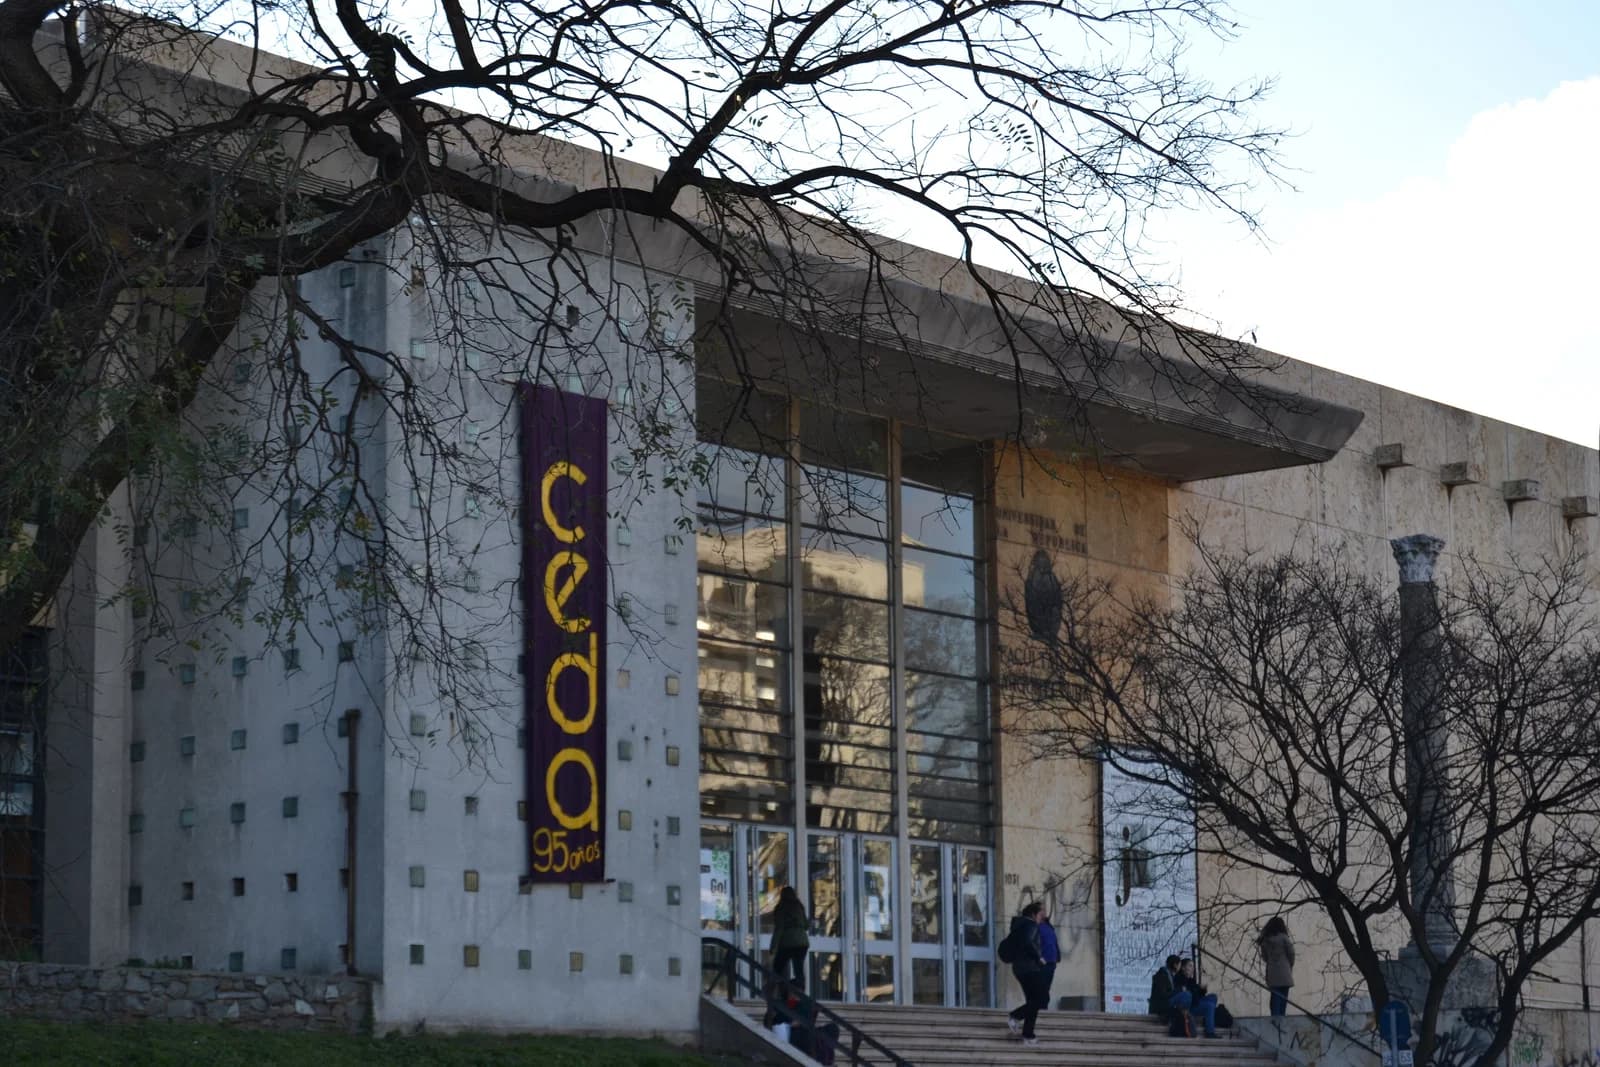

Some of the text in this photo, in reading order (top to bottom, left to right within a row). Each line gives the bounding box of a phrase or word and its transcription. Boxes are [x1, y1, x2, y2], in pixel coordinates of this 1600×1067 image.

[533, 827, 600, 873] 95 años
[710, 878, 727, 894] Go!
